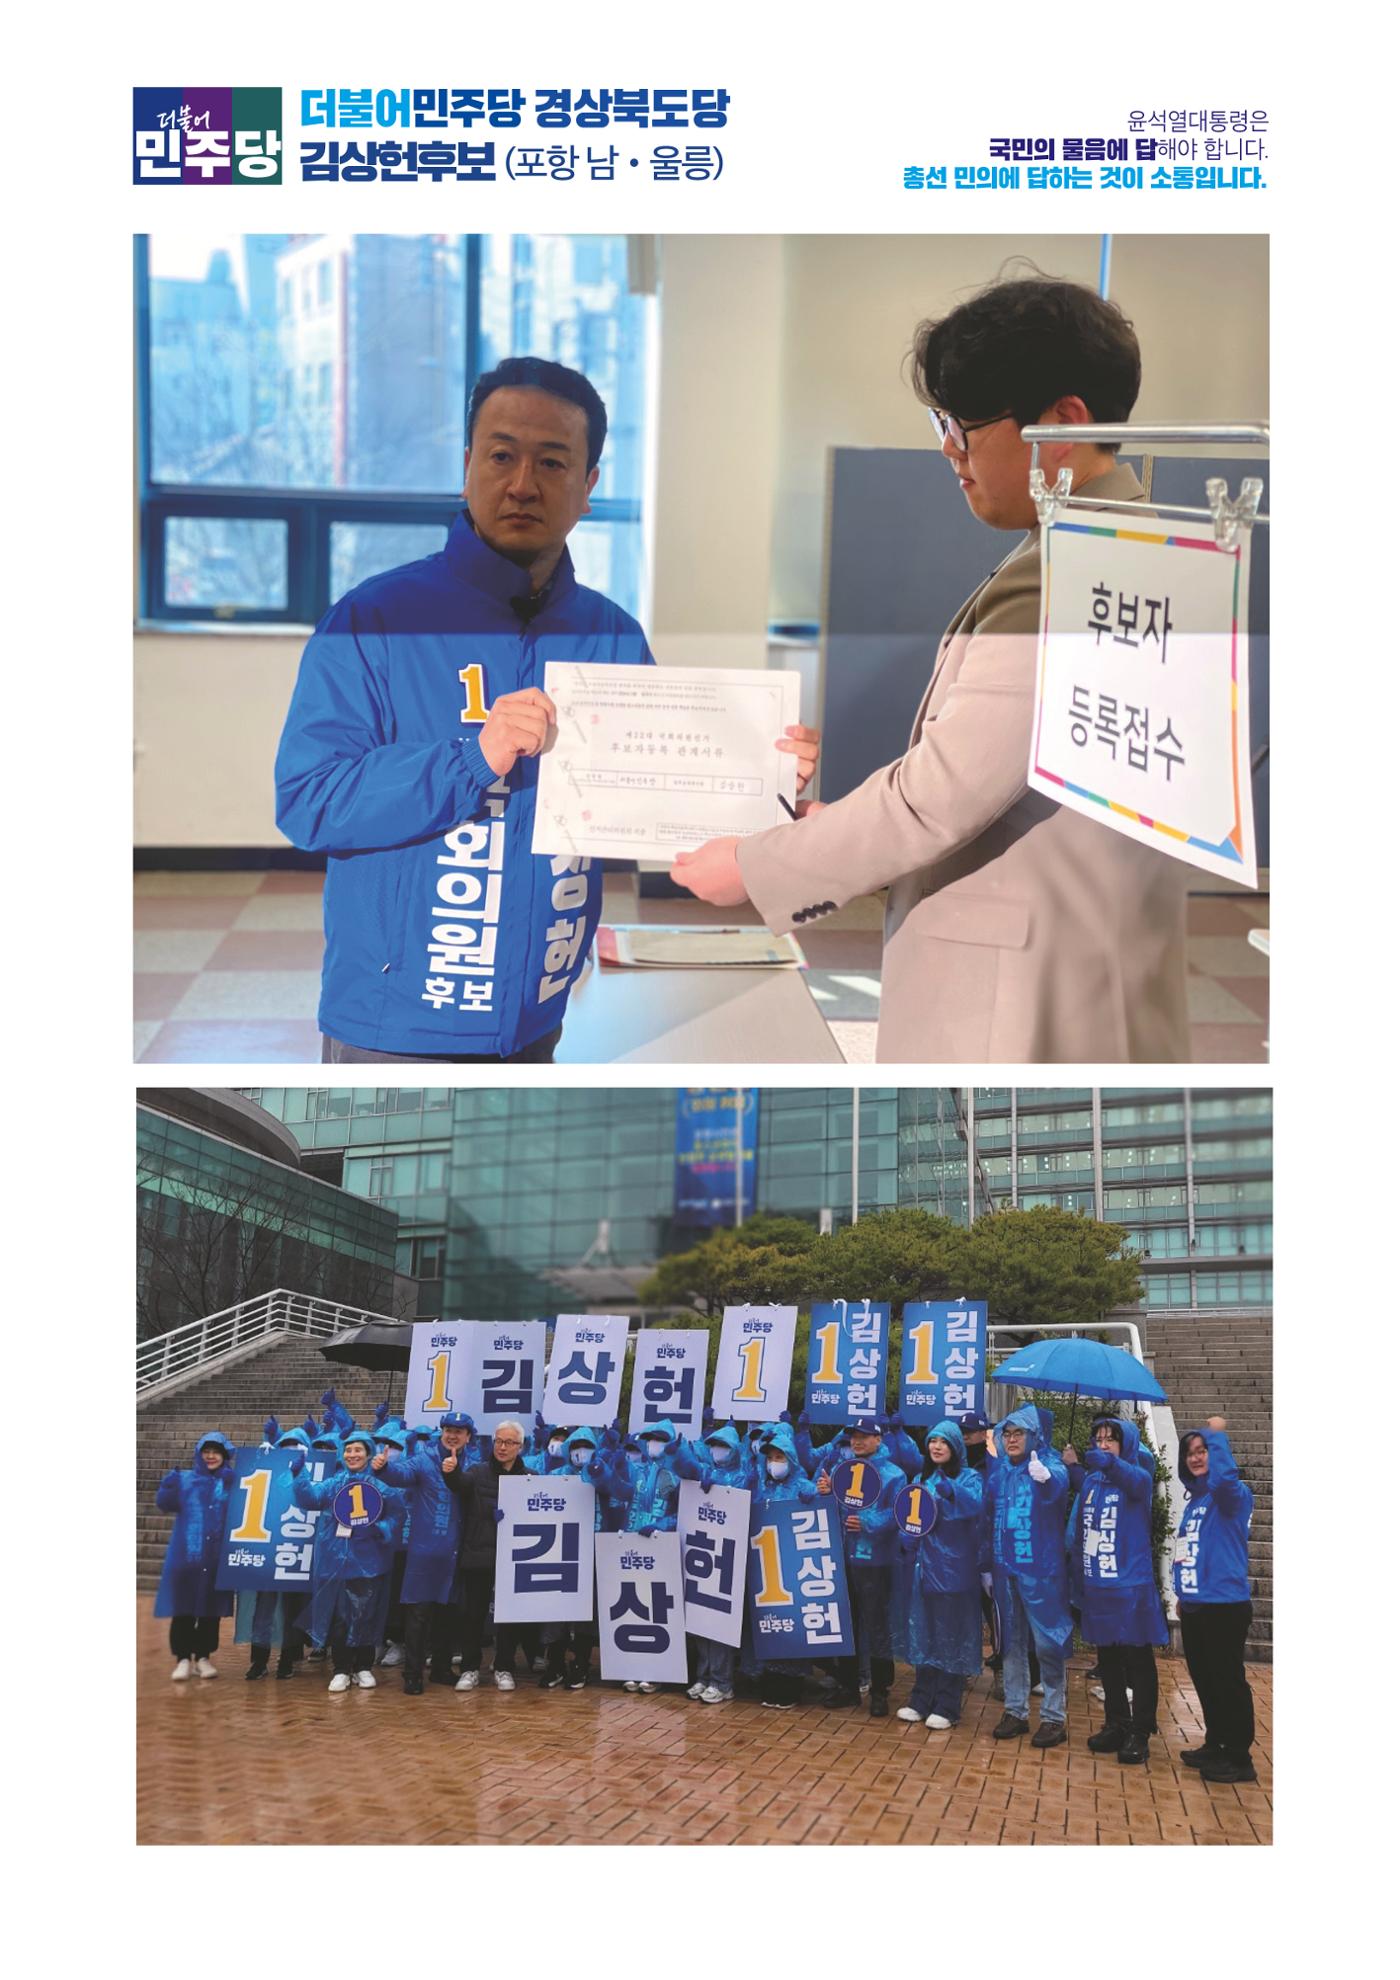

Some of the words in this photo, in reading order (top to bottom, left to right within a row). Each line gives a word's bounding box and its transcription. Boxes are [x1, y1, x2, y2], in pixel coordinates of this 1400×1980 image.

[1088, 581, 1173, 663] 후보자
[458, 663, 490, 724] 1
[1068, 685, 1186, 781] 등록접수
[422, 977, 493, 1012] 후보
[431, 1336, 457, 1347] 민주당
[494, 1339, 524, 1350] 민주당
[575, 1332, 605, 1343] 민주당
[657, 1347, 686, 1359] 민주당
[743, 1321, 773, 1333] 민주당
[812, 1321, 843, 1384] 1
[905, 1320, 939, 1384] 1
[421, 1350, 453, 1413] 1
[481, 1359, 534, 1414] 김
[557, 1351, 615, 1405] 상
[731, 1337, 766, 1402] 1
[847, 1312, 881, 1416] 김상헌
[943, 1311, 978, 1416] 김상헌
[643, 1365, 696, 1424] 헌
[811, 1392, 840, 1405] 민주당
[906, 1392, 936, 1405] 민주당
[229, 1469, 272, 1543] 1
[348, 1485, 368, 1518] 1
[527, 1499, 566, 1511] 민주당
[845, 1463, 865, 1499] 1
[906, 1488, 922, 1525] 1
[697, 1507, 727, 1526] 민주당
[227, 1553, 265, 1567] 민주당
[511, 1522, 580, 1593] 김
[620, 1555, 655, 1570] 민주당
[685, 1529, 736, 1614] 헌
[751, 1525, 794, 1607] 1
[791, 1509, 843, 1646] 김상헌
[610, 1581, 674, 1654] 상
[758, 1619, 796, 1633] 민주당
